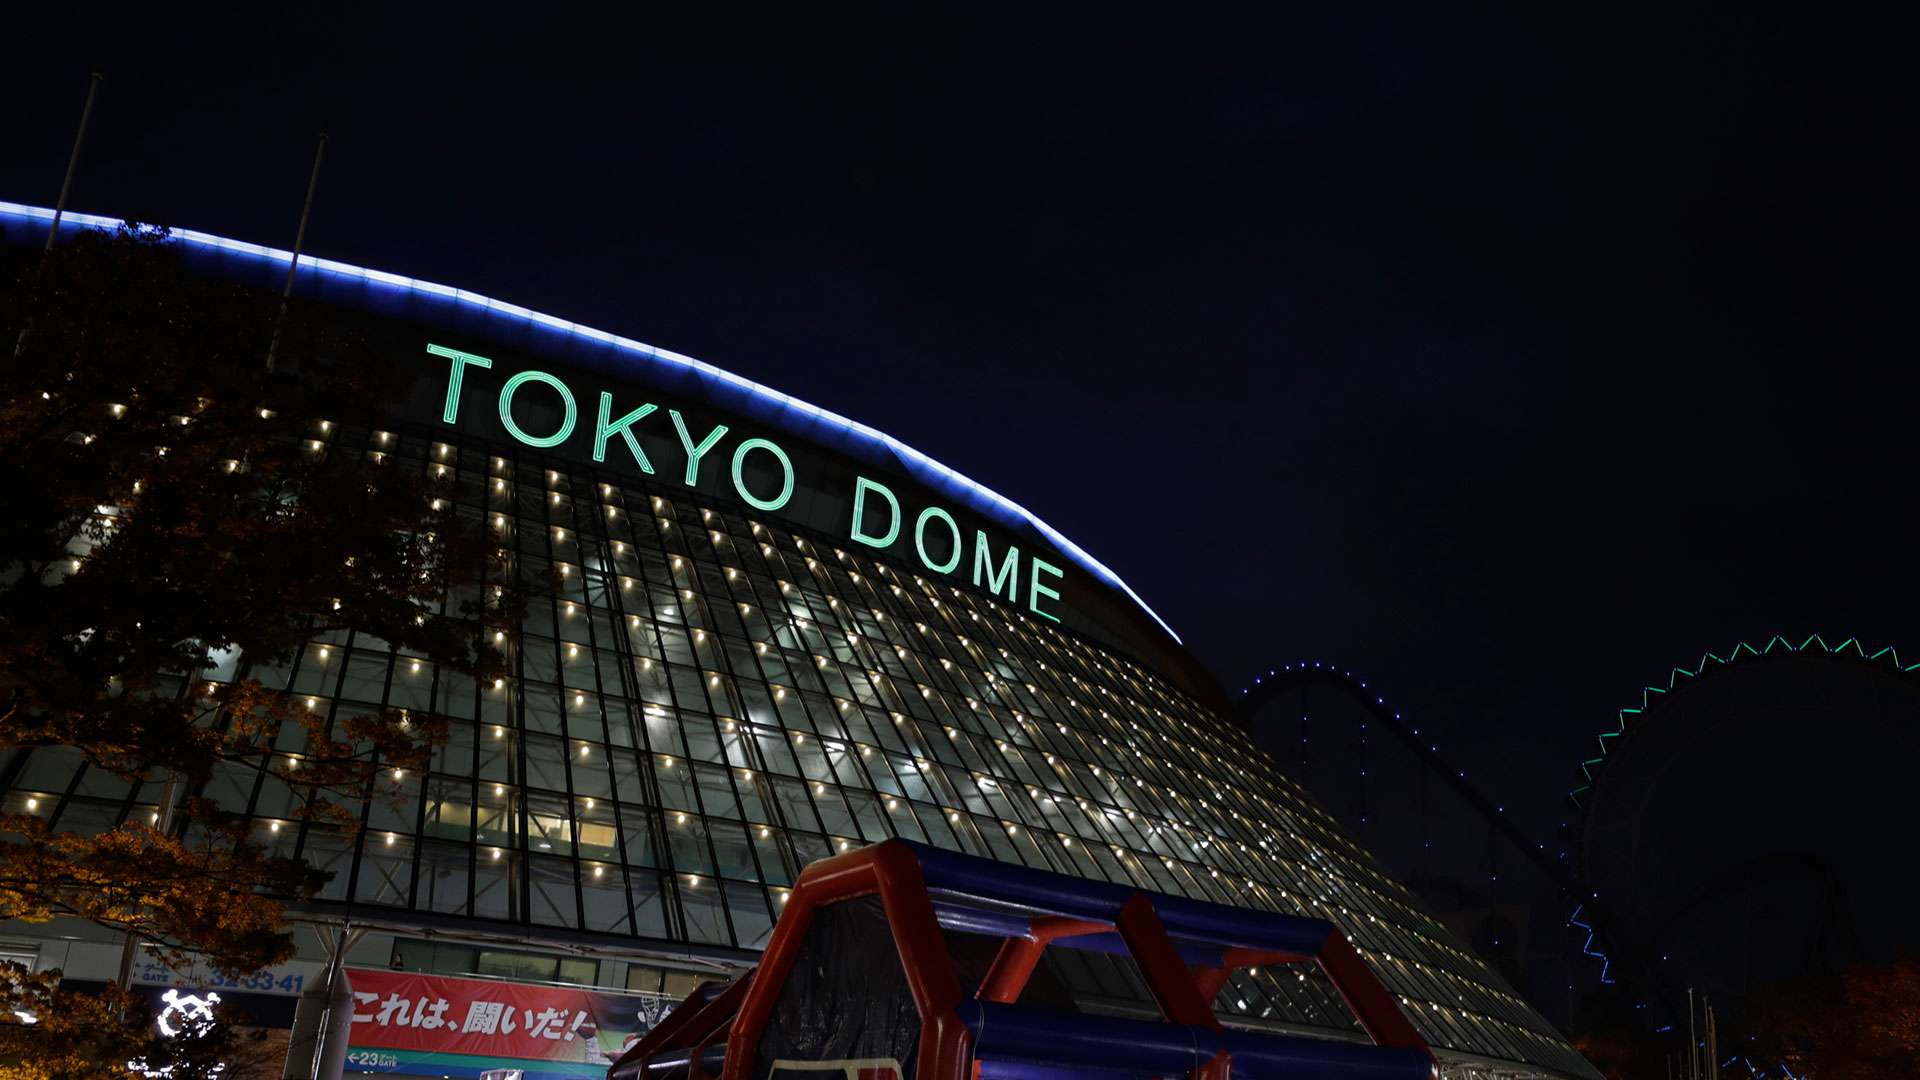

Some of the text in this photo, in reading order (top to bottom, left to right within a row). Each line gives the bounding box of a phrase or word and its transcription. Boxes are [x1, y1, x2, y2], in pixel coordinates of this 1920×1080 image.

[427, 344, 1063, 623] TOKYO DOME
[359, 1051, 378, 1066] 23
